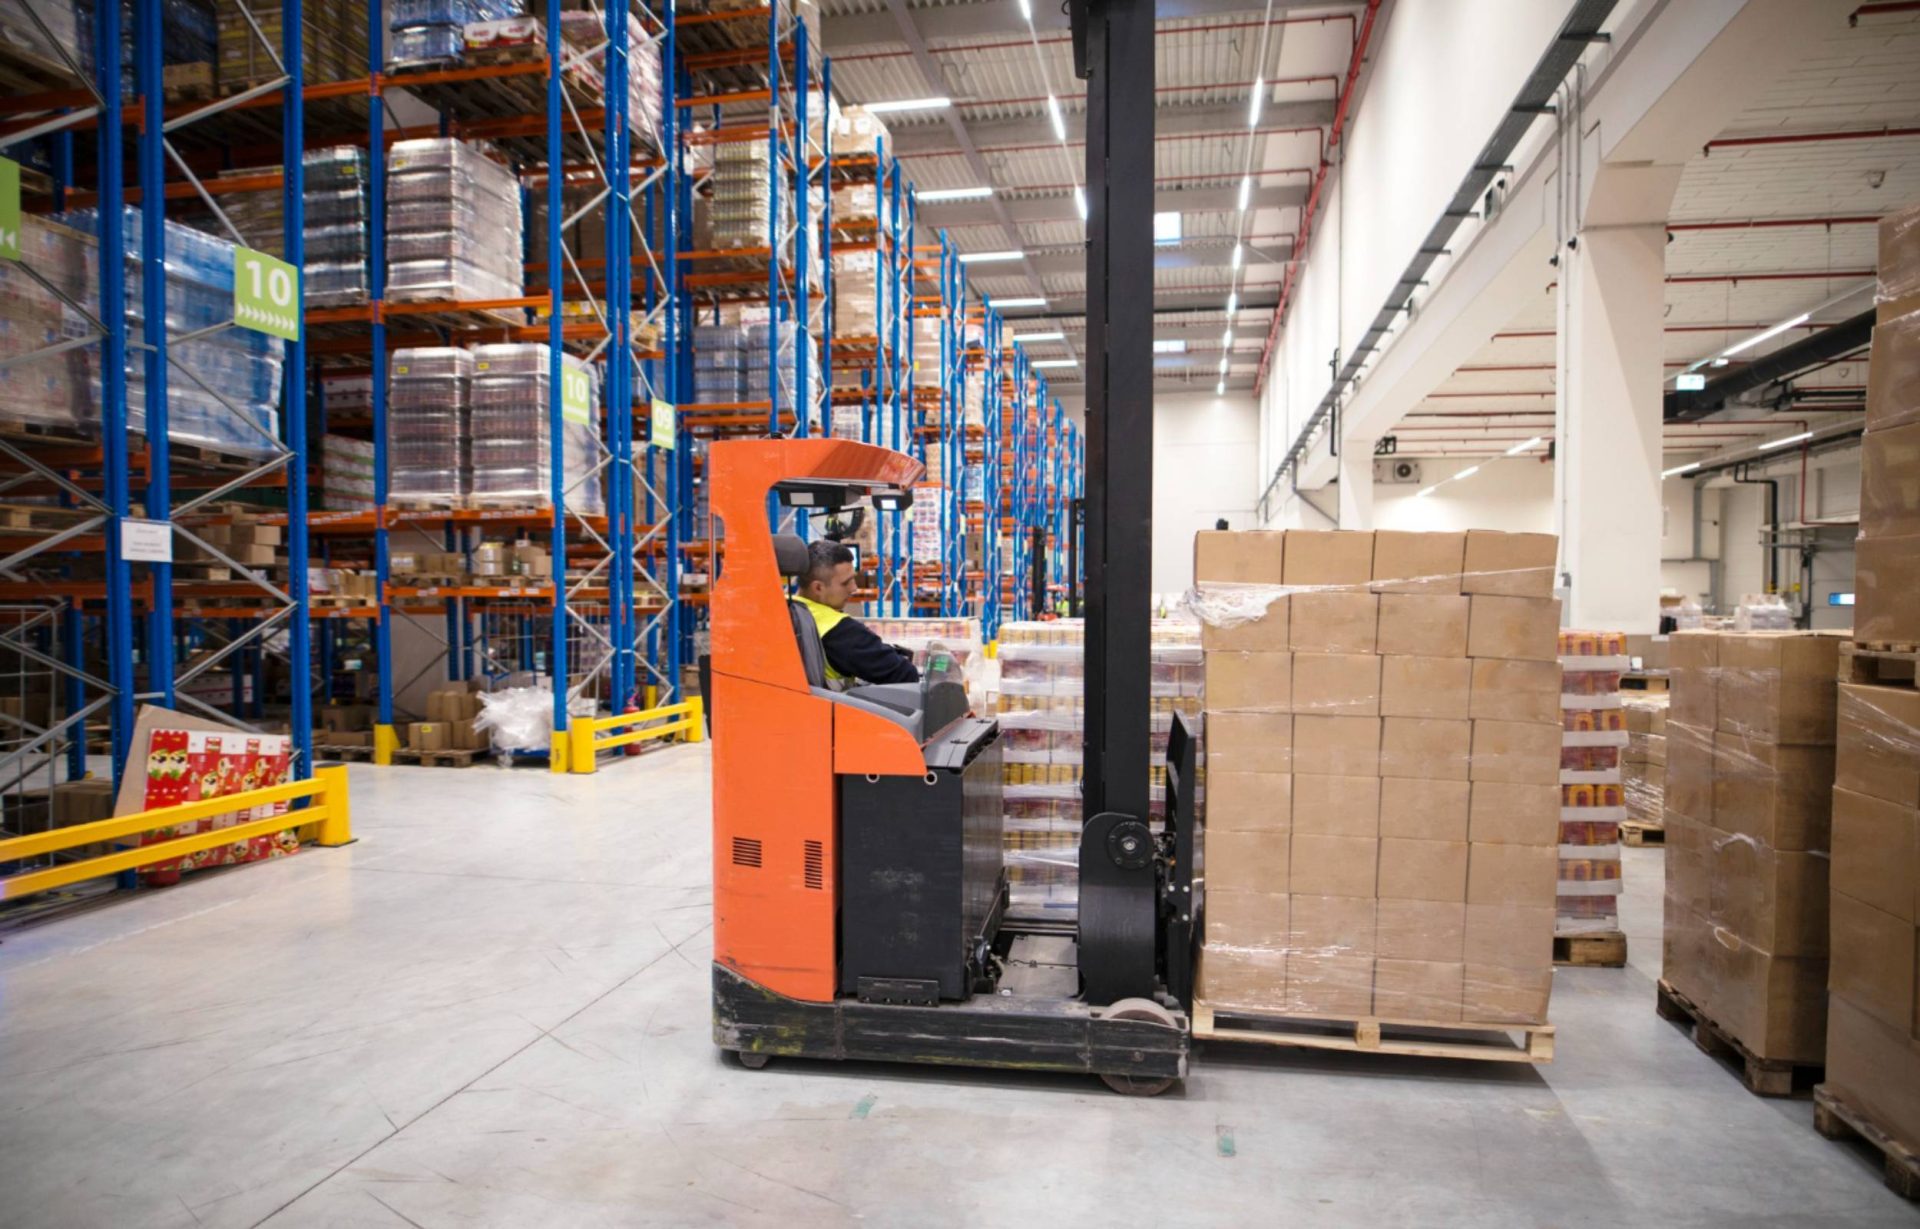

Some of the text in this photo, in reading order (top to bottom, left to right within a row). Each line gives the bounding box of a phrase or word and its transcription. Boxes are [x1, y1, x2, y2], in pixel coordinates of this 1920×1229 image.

[245, 261, 291, 306] 10
[566, 373, 586, 402] 10
[655, 406, 672, 429] 09
